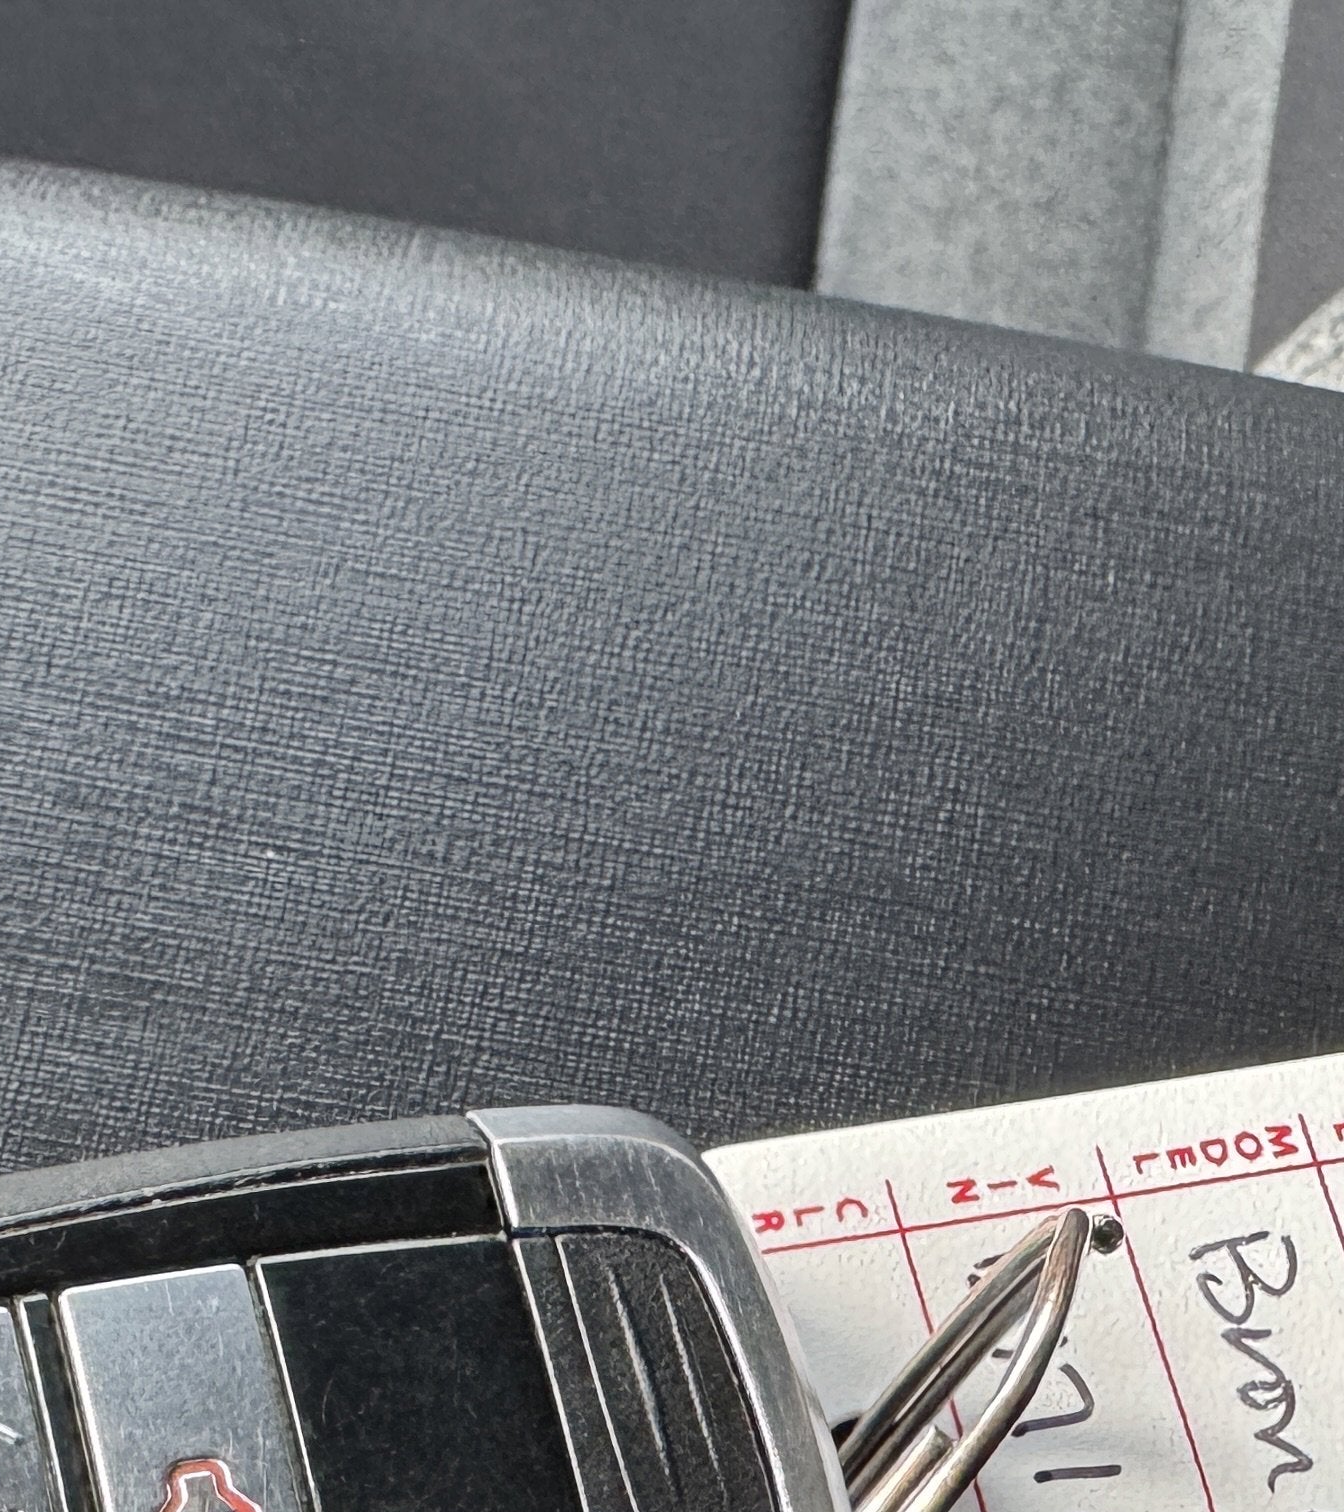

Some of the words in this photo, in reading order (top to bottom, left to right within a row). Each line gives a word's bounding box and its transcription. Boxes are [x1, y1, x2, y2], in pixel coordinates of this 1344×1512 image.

[1132, 1124, 1300, 1175] MODEL
[946, 1164, 1061, 1205] VIN
[751, 1197, 869, 1234] CLR
